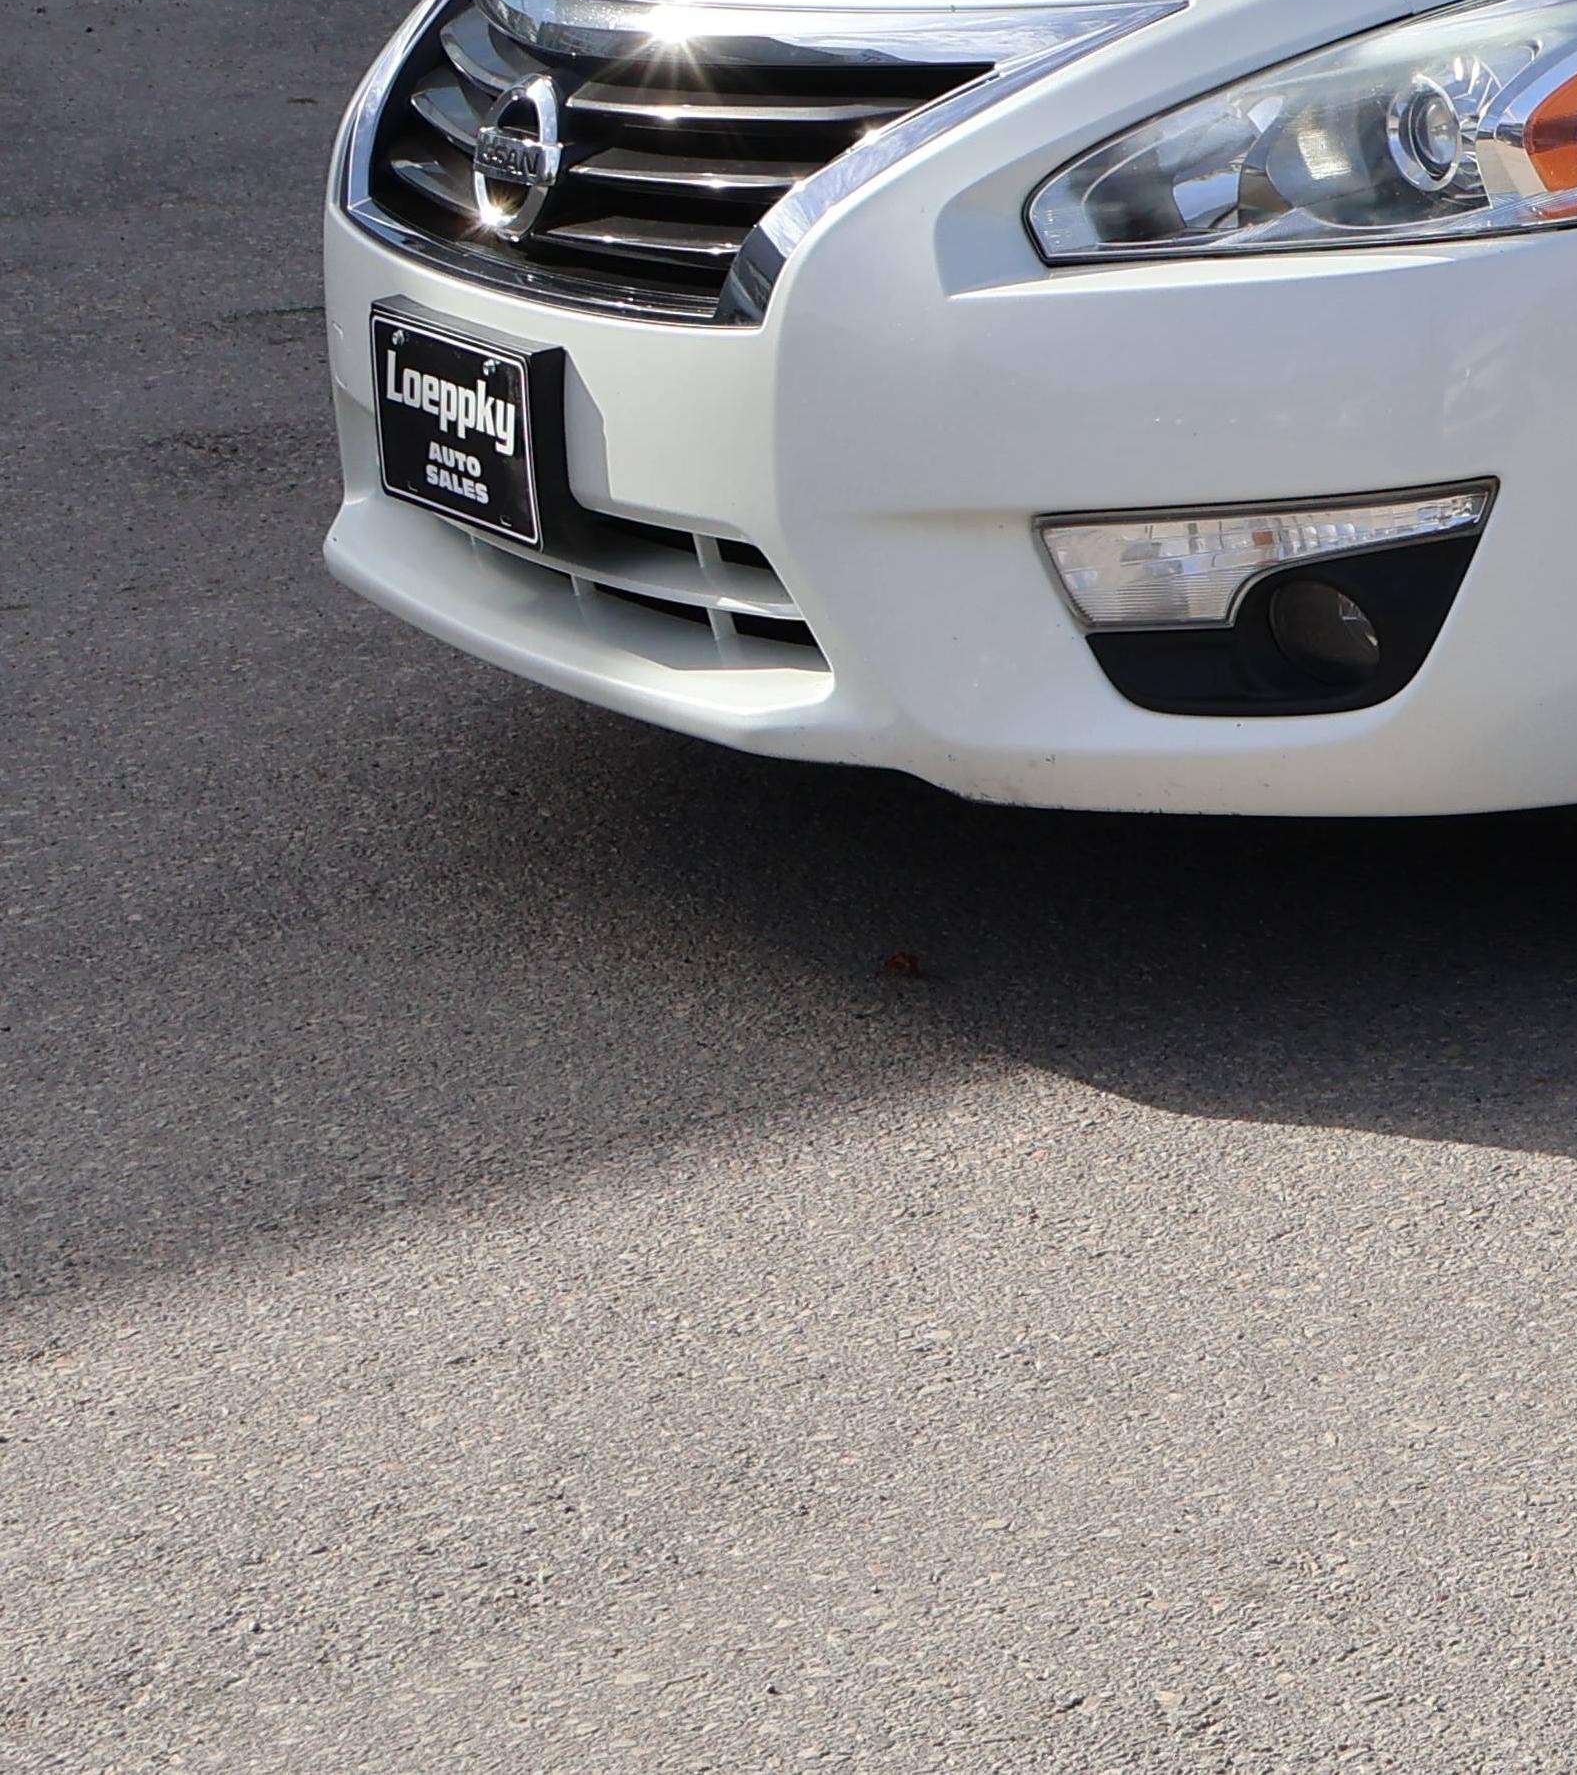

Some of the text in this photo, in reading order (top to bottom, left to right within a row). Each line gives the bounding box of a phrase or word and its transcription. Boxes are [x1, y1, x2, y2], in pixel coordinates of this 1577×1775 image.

[386, 349, 516, 456] Loeppky
[428, 440, 482, 478] AUTO
[425, 463, 490, 505] SALES
